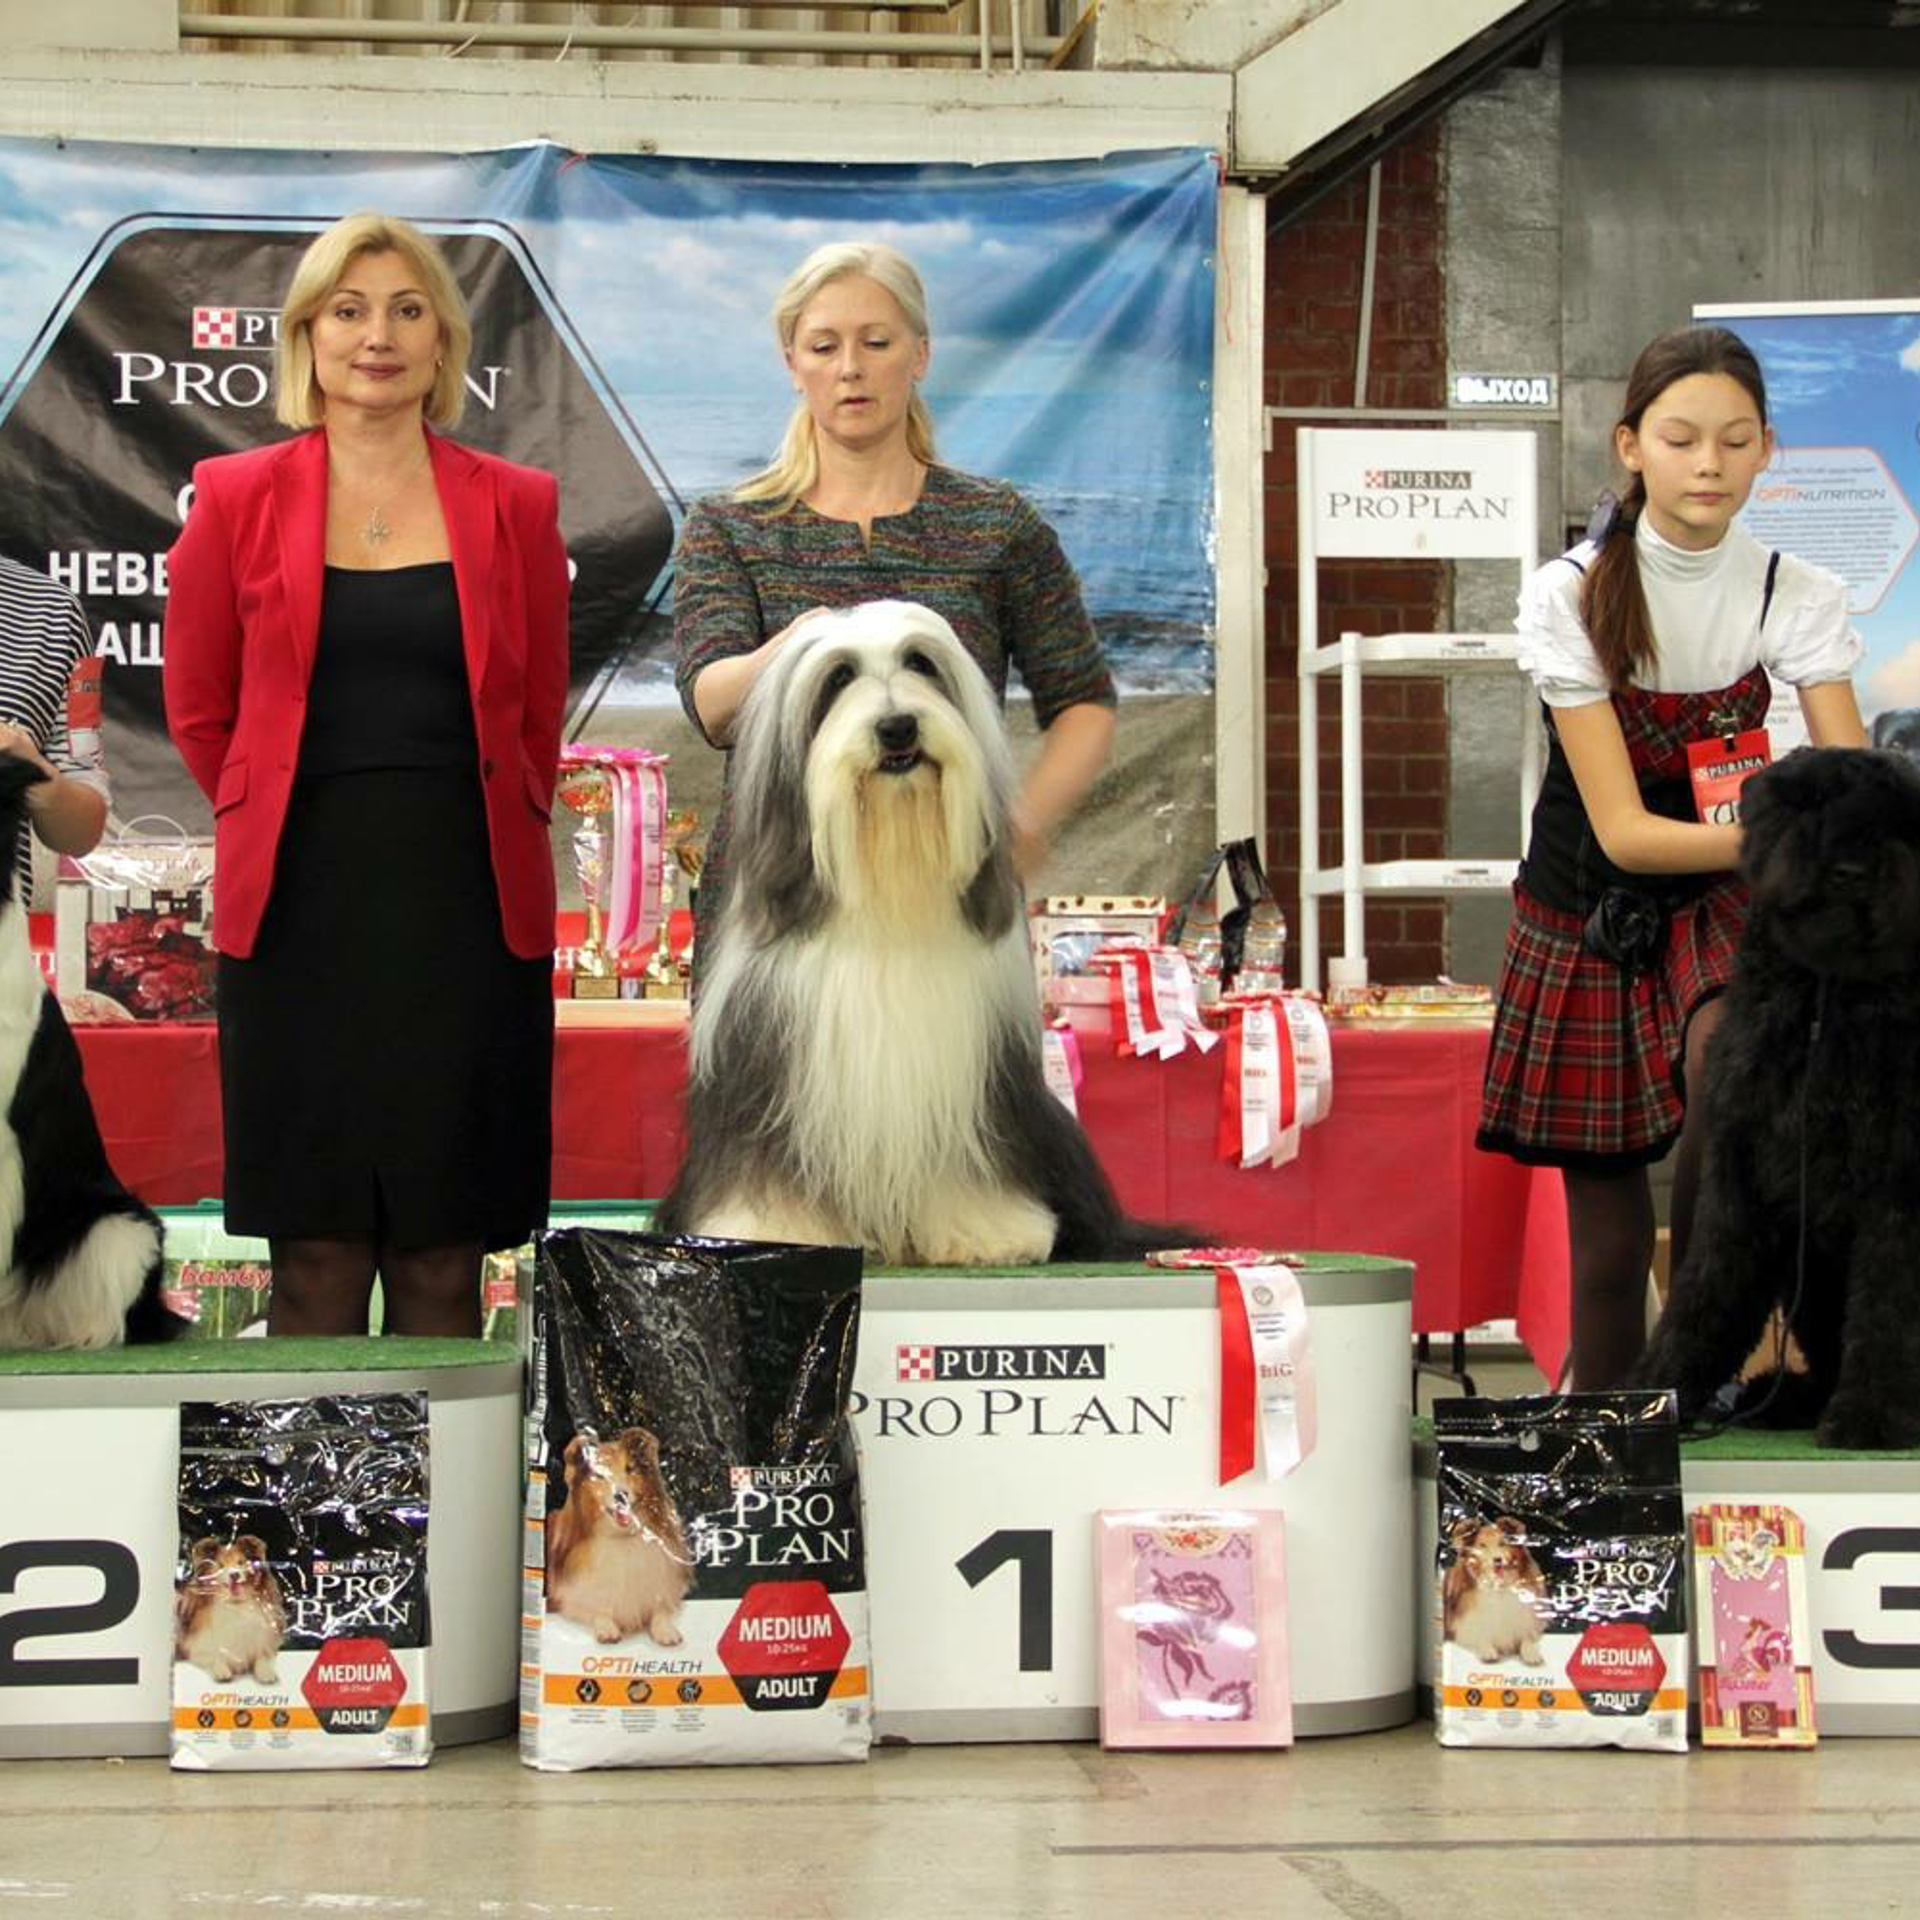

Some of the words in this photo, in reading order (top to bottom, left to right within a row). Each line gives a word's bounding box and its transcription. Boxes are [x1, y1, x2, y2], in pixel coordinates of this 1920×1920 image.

[112, 352, 268, 408] PRO
[1456, 377, 1549, 405] ВЫХОД
[1387, 472, 1470, 488] PURINA
[1329, 493, 1400, 519] PRO
[1408, 493, 1510, 519] PLAN
[1708, 756, 1764, 779] PURINA
[938, 1349, 1099, 1376] PURINA
[977, 1388, 1178, 1437] PLAN
[754, 1469, 831, 1485] PURINA
[732, 1490, 835, 1528] PRO
[706, 1529, 855, 1567] PLAN
[1575, 1558, 1655, 1586] PRO
[313, 1575, 395, 1600] PRO
[955, 1529, 1052, 1671] 1
[1822, 1528, 1920, 1669] 3
[0, 1540, 140, 1686] 2
[296, 1599, 411, 1627] PLAN
[738, 1614, 832, 1642] MEDIUM
[582, 1657, 704, 1675] OPTIHEALTH
[1582, 1648, 1654, 1666] MEDIUM
[318, 1664, 392, 1683] MEDIUM
[755, 1677, 818, 1699] ADULT
[1593, 1692, 1641, 1707] ADULT
[330, 1709, 379, 1725] ADULT
